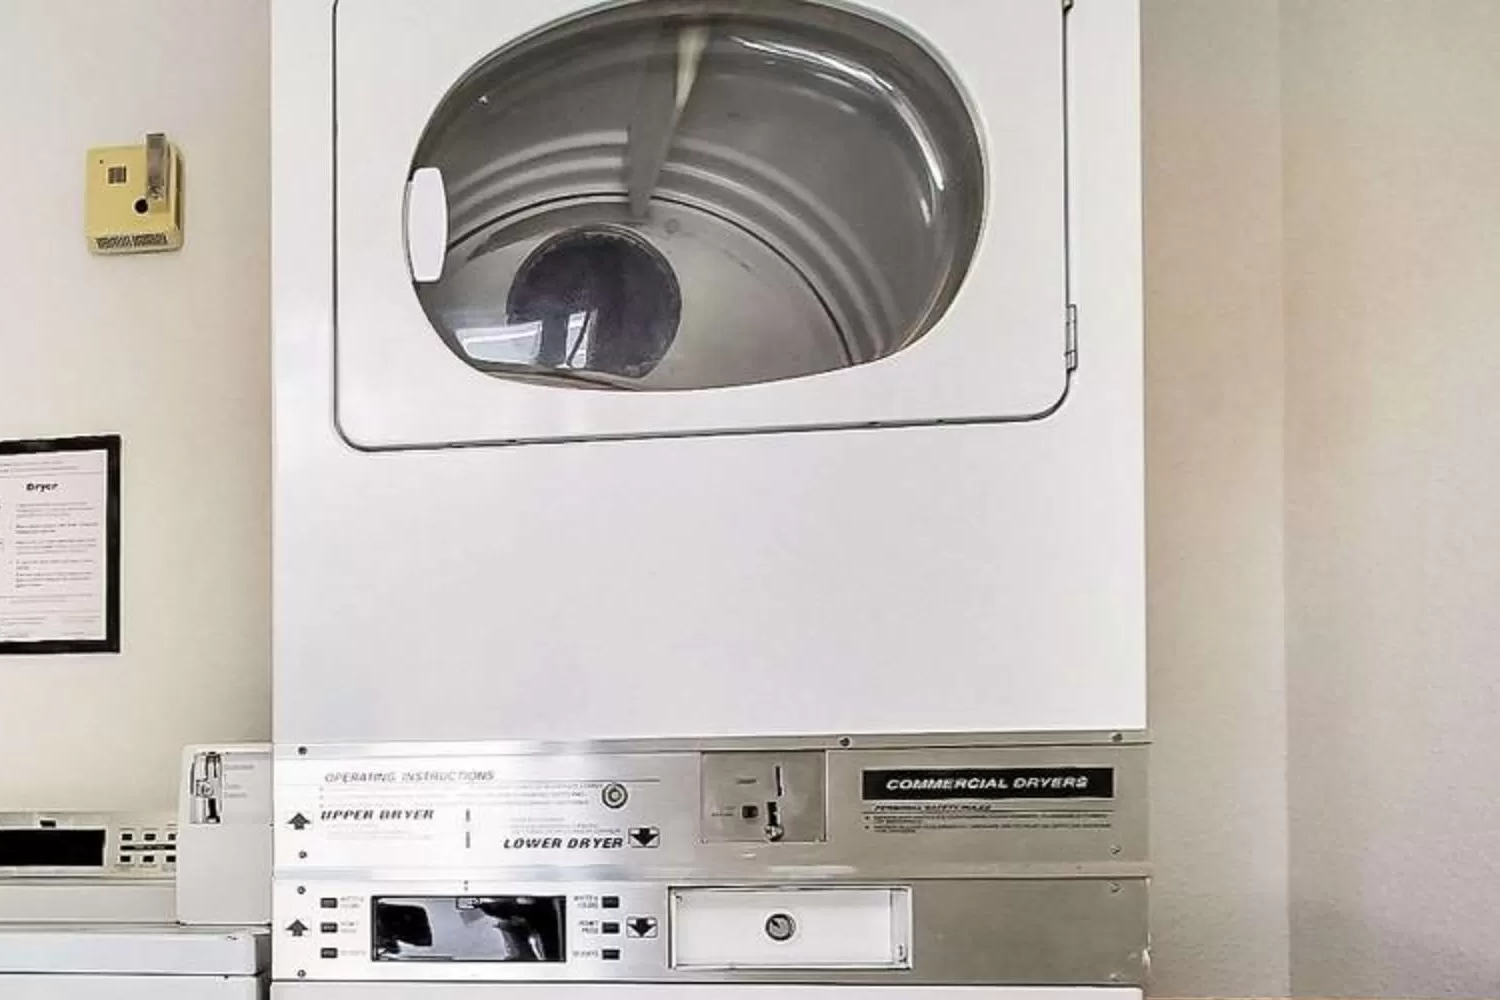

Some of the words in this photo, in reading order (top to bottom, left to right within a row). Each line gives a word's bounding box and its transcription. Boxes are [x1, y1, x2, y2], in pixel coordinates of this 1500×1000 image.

[26, 483, 59, 493] Dryer
[324, 772, 398, 783] OPERATING
[401, 770, 495, 783] INSTRUCTIONS
[885, 778, 1009, 791] COMMERCIAL
[1013, 775, 1089, 789] DRYERS
[320, 808, 375, 821] UPPER
[378, 808, 436, 821] DRYER
[503, 837, 562, 849] LOWER
[566, 836, 625, 849] DRYER
